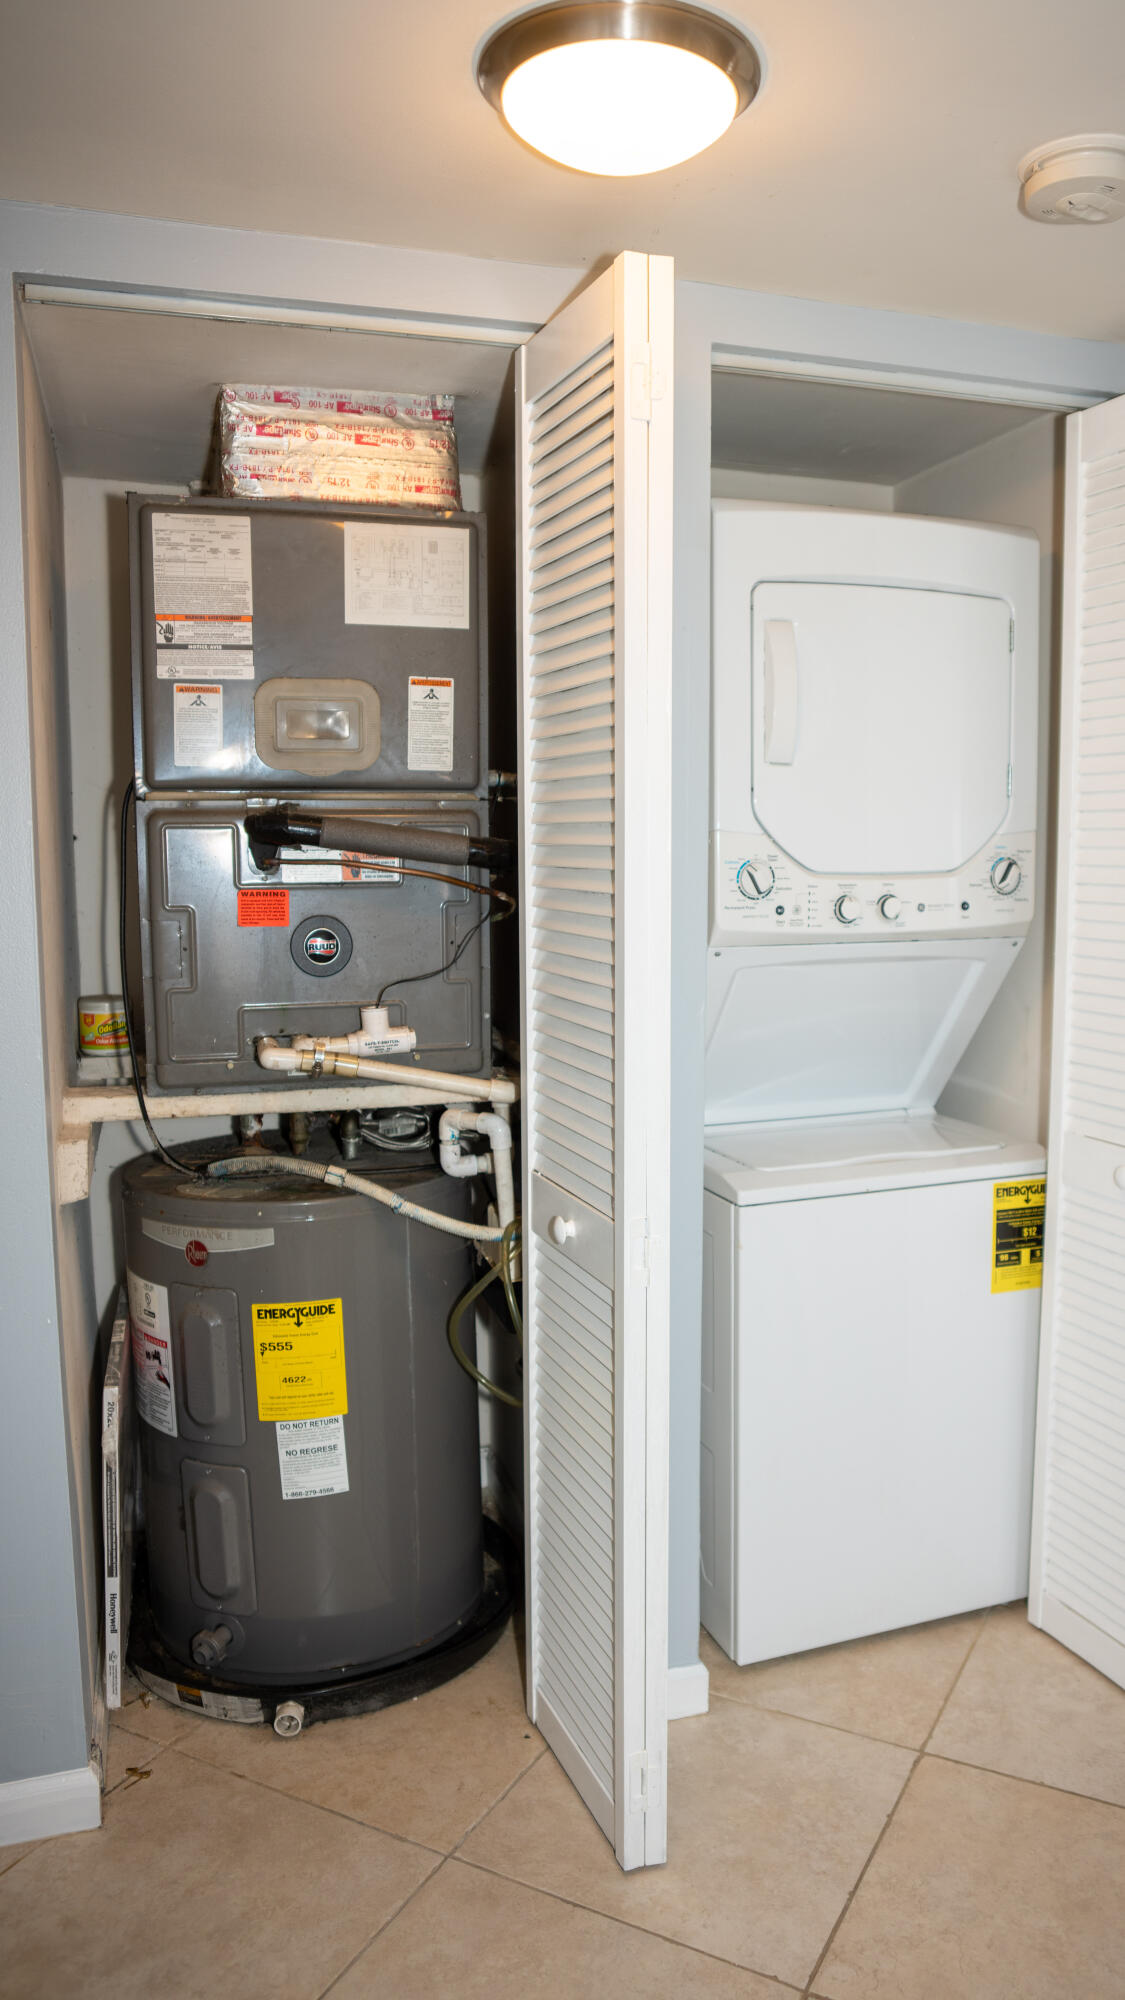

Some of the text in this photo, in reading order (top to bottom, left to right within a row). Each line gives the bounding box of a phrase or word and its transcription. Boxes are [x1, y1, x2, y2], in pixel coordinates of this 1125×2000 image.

[308, 943, 336, 951] RUUD
[161, 1225, 233, 1241] PERFORMANCE
[256, 1304, 336, 1320] ENERGYGUIDE
[260, 1342, 293, 1352] $555
[282, 1376, 306, 1384] 4622
[293, 1422, 308, 1430] NOT
[309, 1418, 339, 1427] RETURN
[300, 1444, 338, 1455] REGRESE
[109, 1593, 117, 1633] Honeywell
